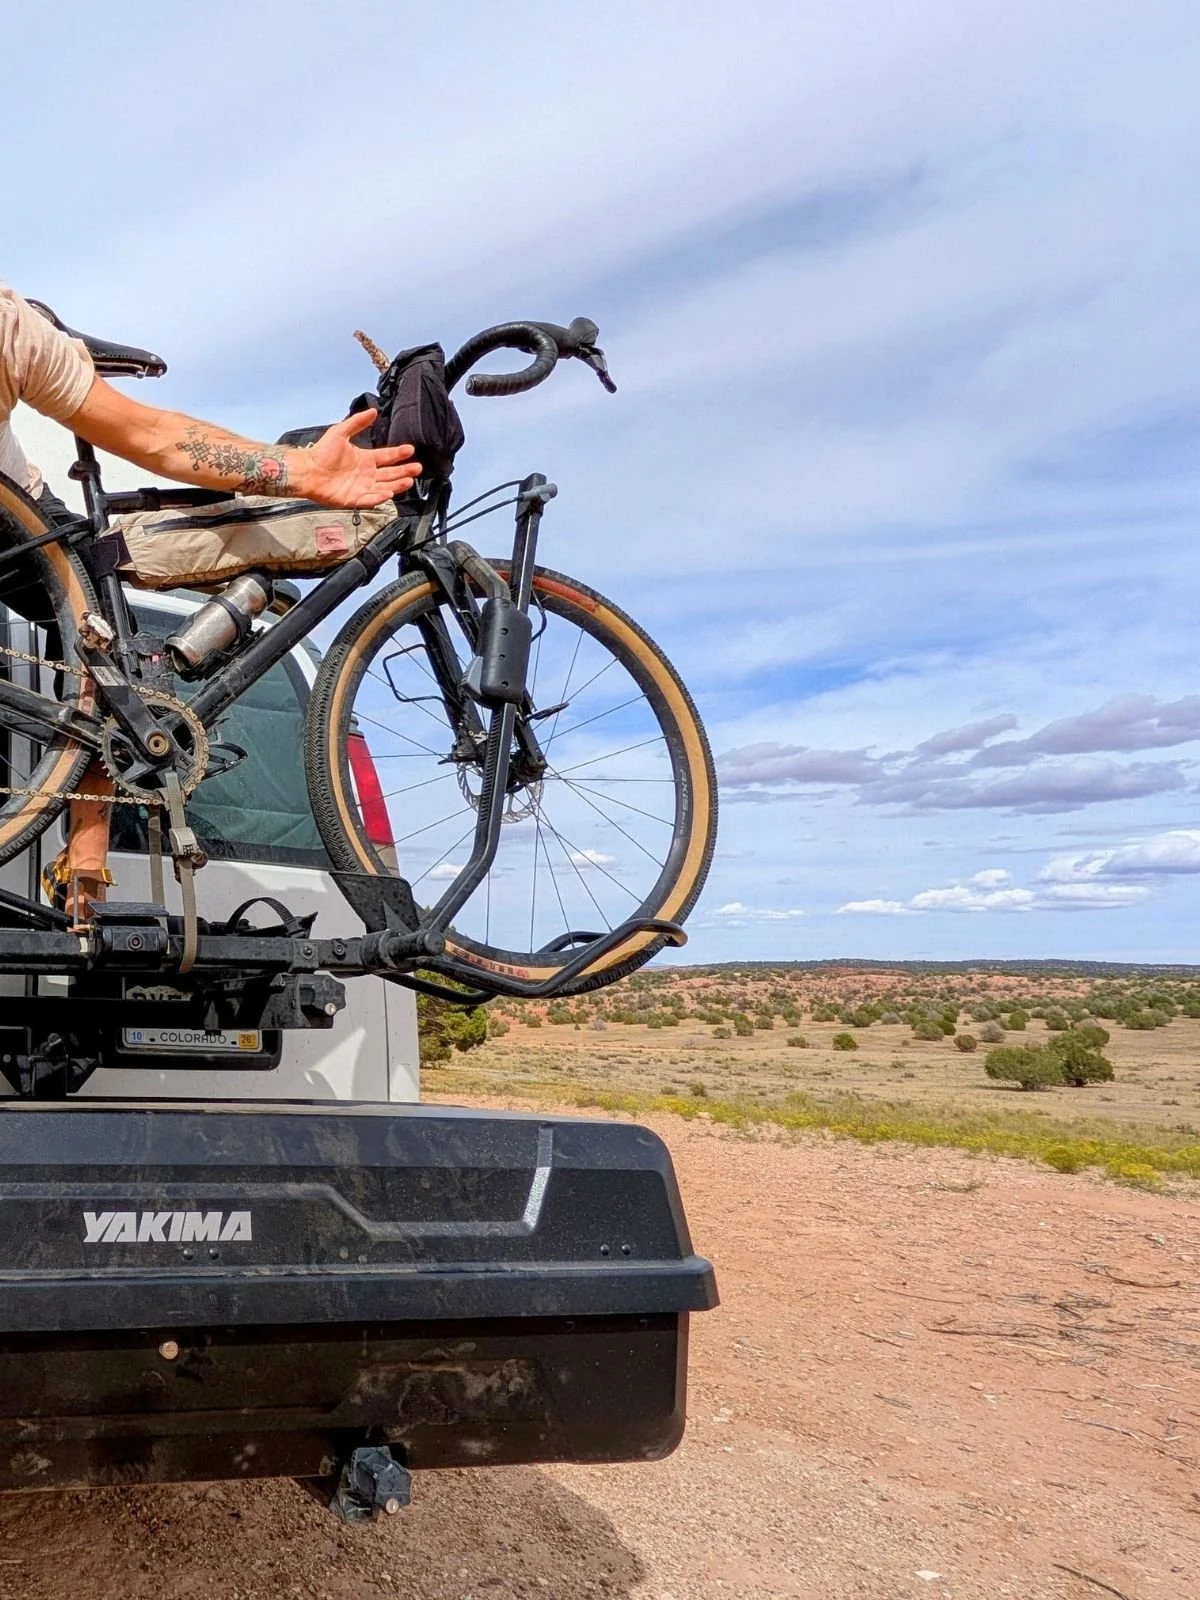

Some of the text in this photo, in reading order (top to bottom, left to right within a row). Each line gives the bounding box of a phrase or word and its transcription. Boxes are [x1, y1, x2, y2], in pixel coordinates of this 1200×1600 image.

[131, 1032, 142, 1041] 10
[160, 1032, 226, 1044] COLORADO
[83, 1211, 252, 1243] YAKIMA
